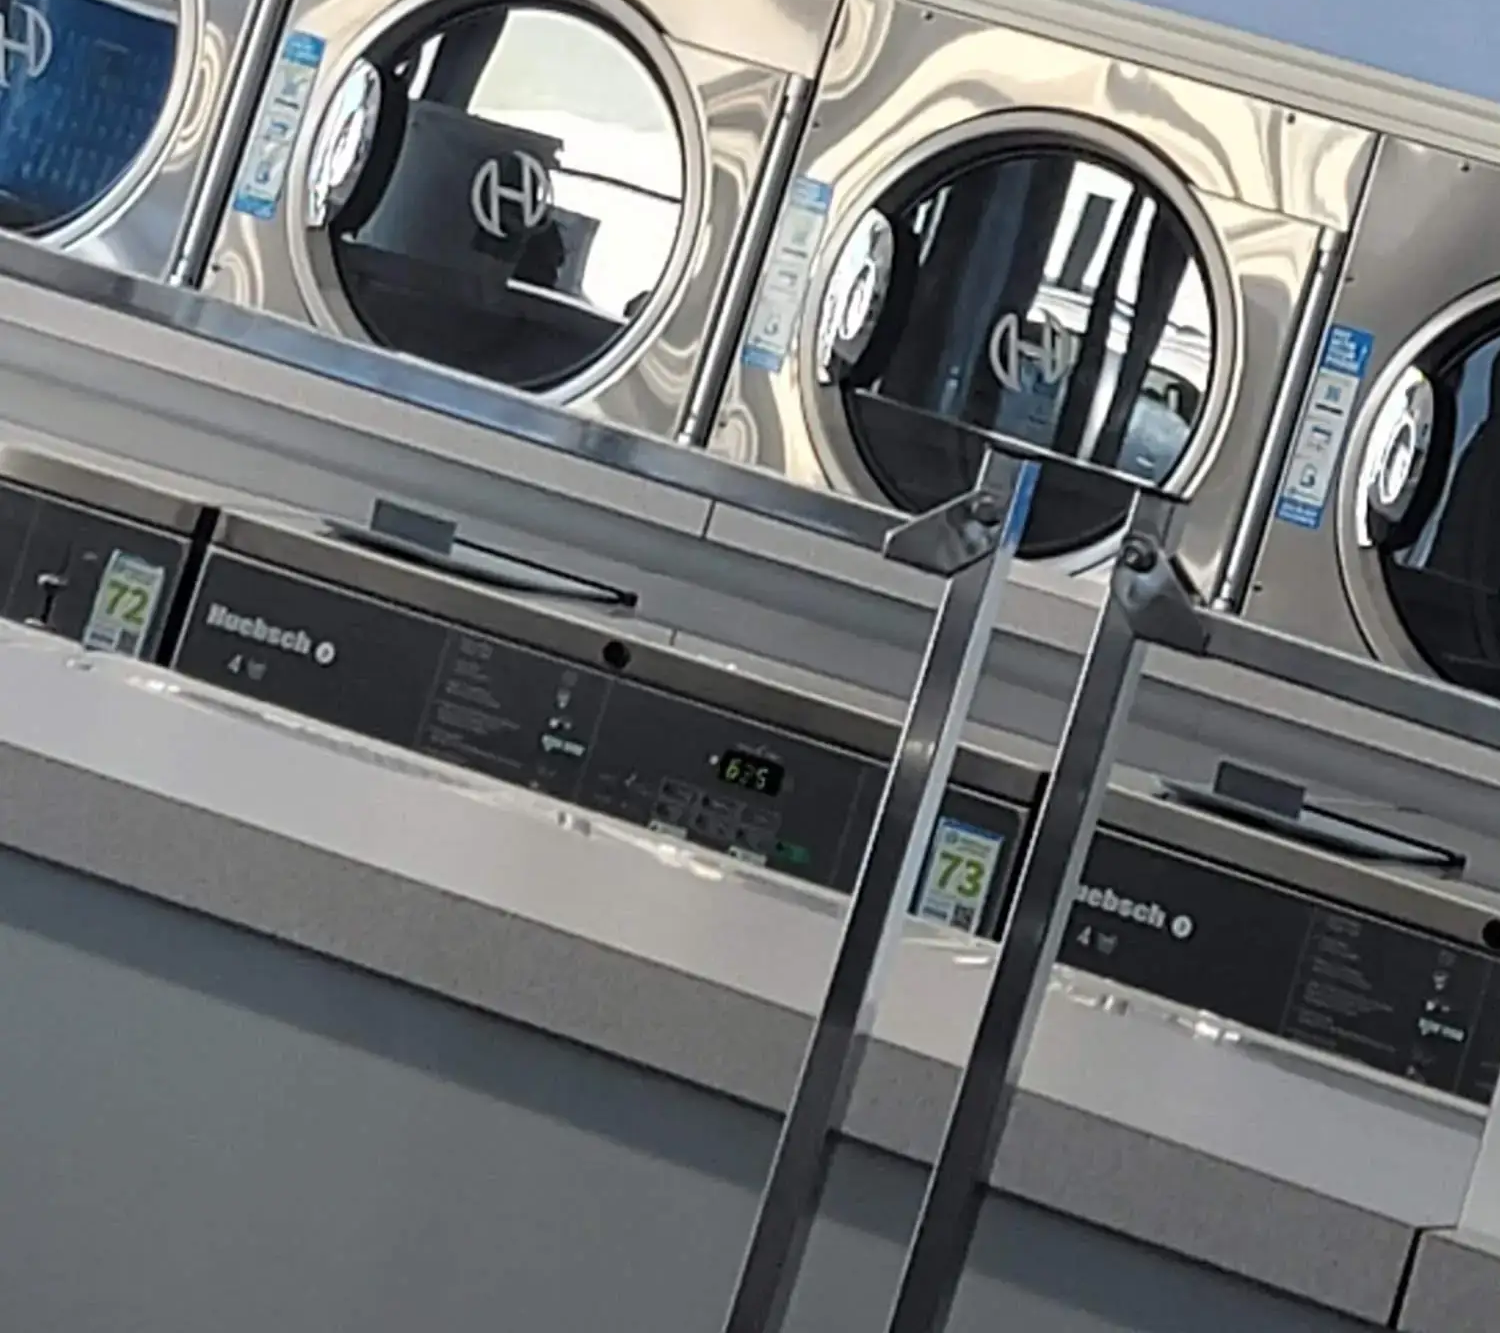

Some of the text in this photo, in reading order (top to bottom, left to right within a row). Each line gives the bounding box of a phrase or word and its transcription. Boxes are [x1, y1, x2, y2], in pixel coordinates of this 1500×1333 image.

[106, 580, 149, 625] 72
[937, 850, 986, 899] 73
[1074, 882, 1167, 930] uebsch
